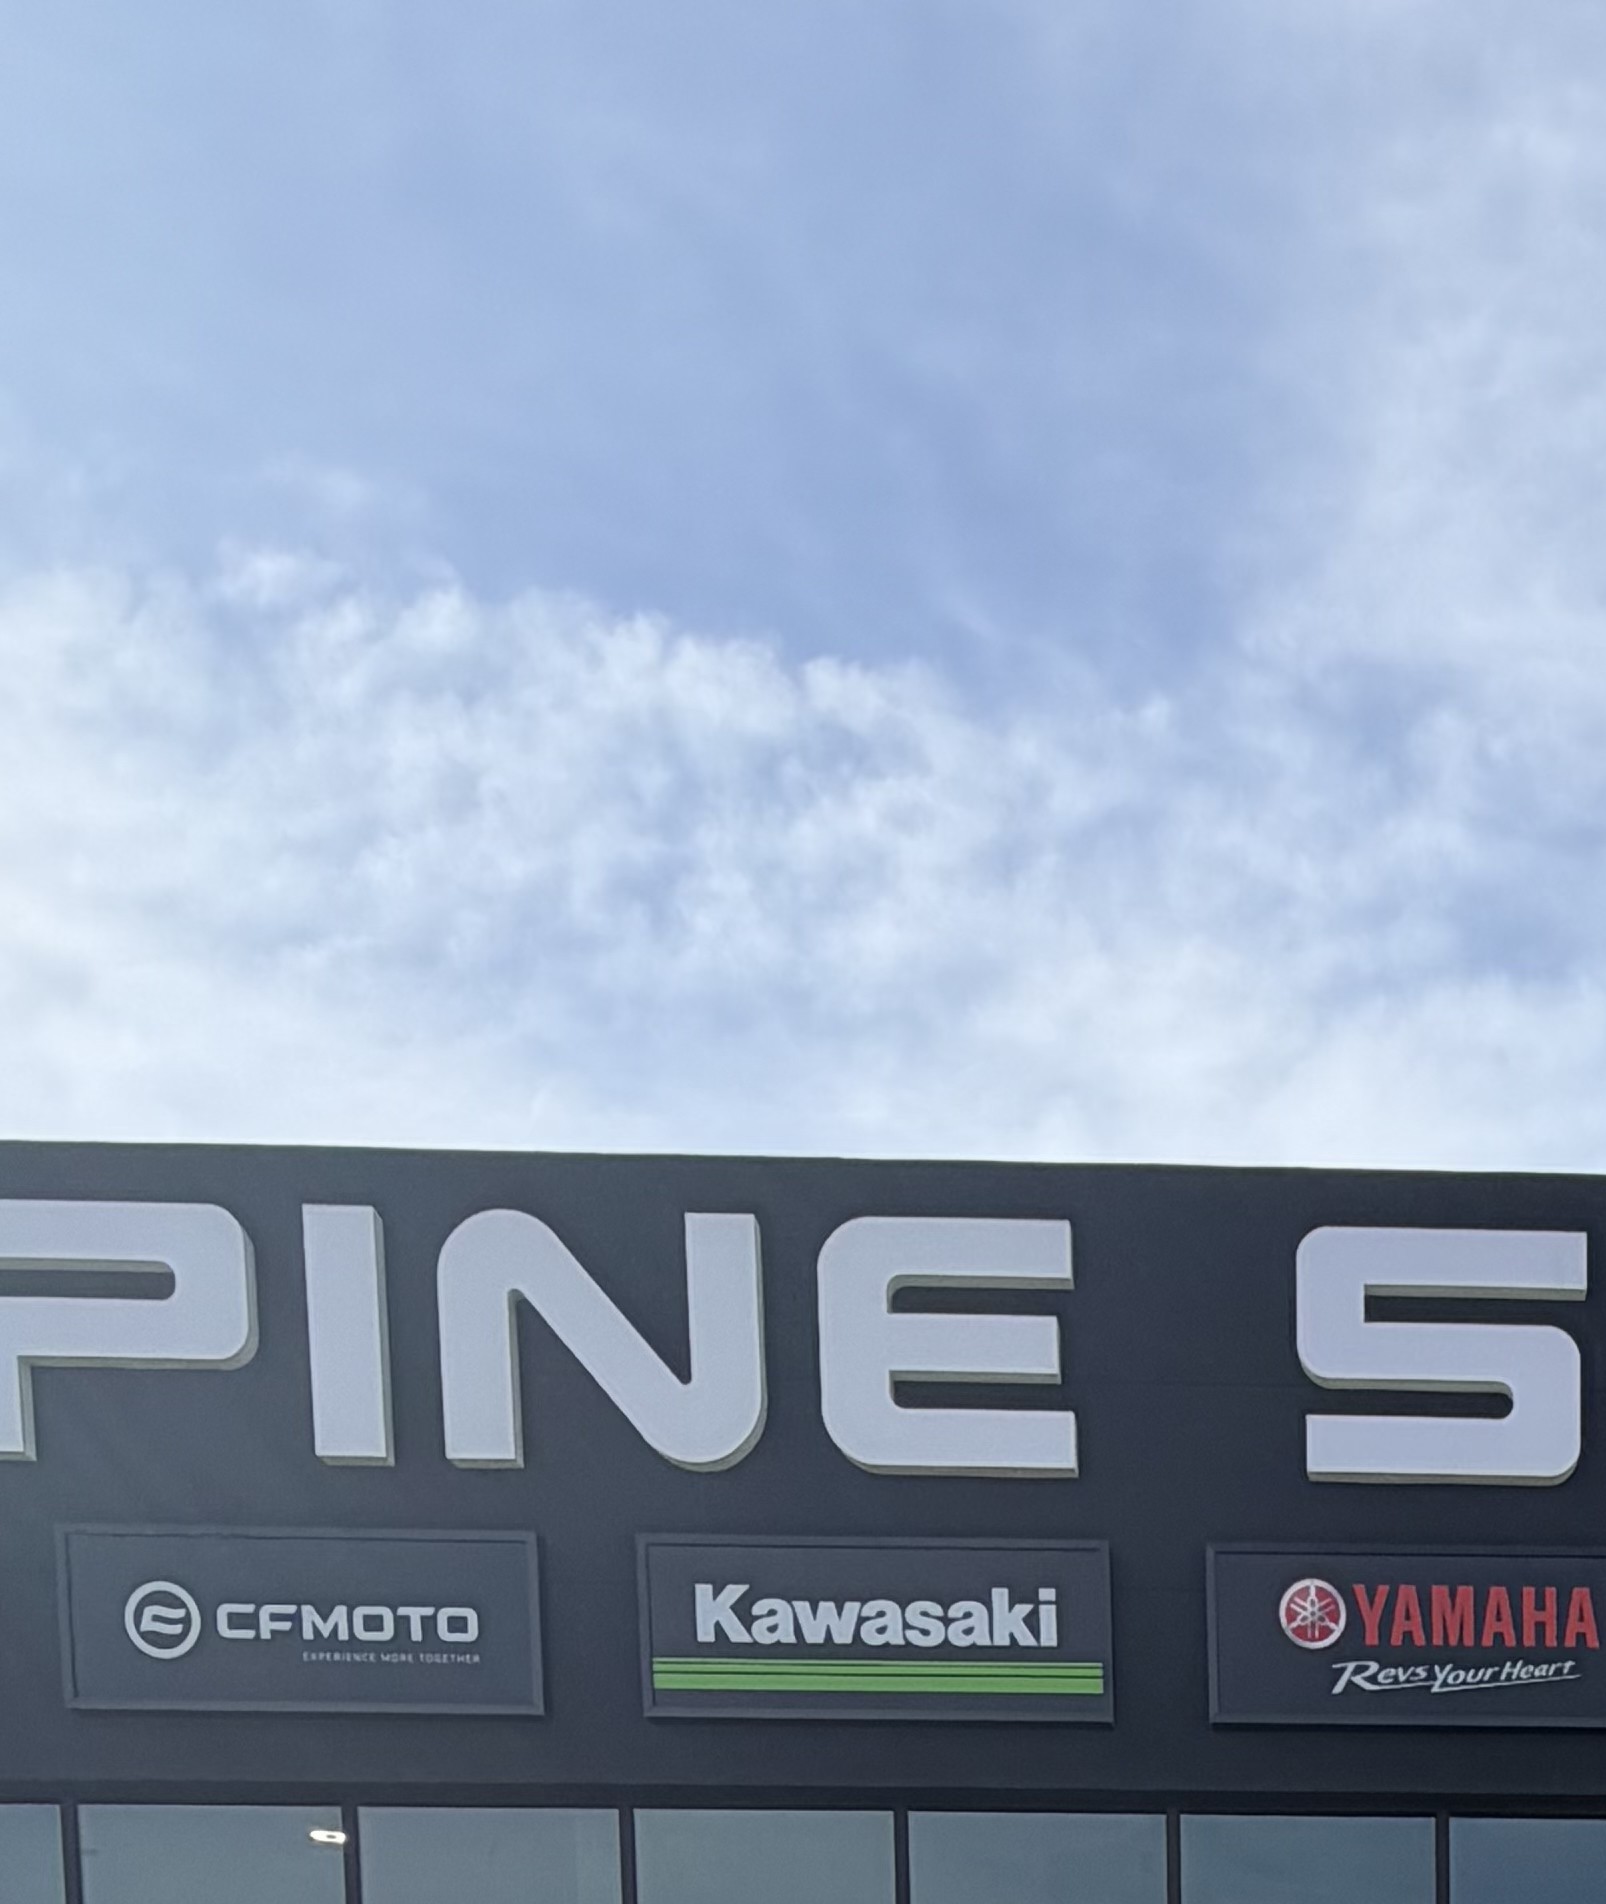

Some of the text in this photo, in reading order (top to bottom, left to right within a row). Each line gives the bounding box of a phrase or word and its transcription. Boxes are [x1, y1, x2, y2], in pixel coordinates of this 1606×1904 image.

[0, 1202, 1078, 1477] PINE
[215, 1602, 479, 1643] CFMOTO
[694, 1583, 1058, 1648] Kawasaki
[1352, 1584, 1600, 1649] YAMAHA
[302, 1651, 481, 1665] EXPERIENCE MORE TOGETHER
[1331, 1659, 1576, 1695] Revs Your Heart
